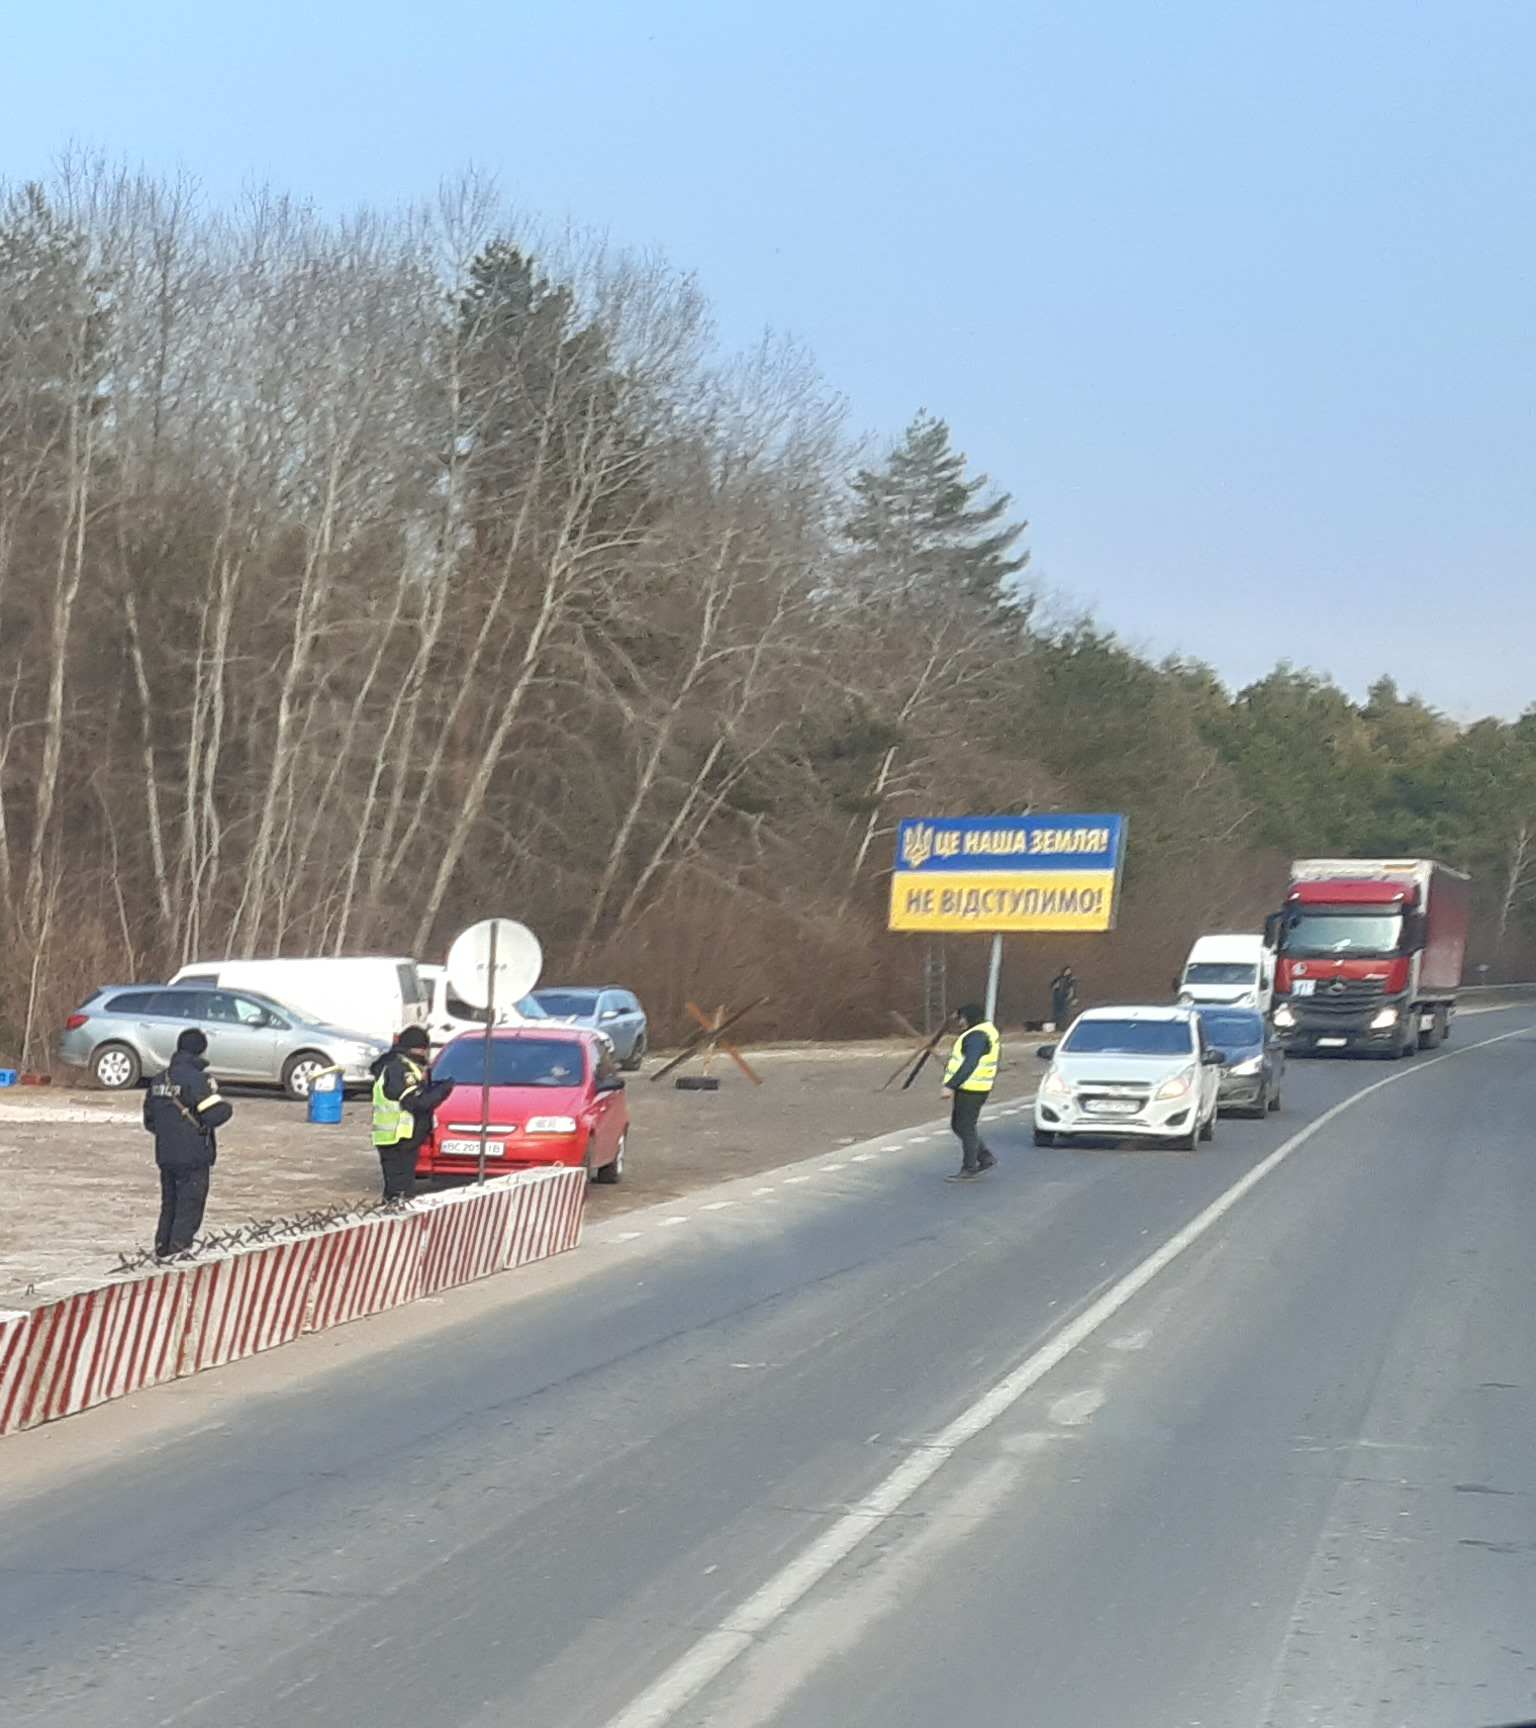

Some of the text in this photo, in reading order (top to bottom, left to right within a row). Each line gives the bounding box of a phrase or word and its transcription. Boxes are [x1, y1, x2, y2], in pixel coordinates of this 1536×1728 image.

[936, 828, 1110, 859] ЦЕ НАША ЗЕМЛЯ!
[906, 887, 1103, 917] НЕ ВІДСТУПИМО!
